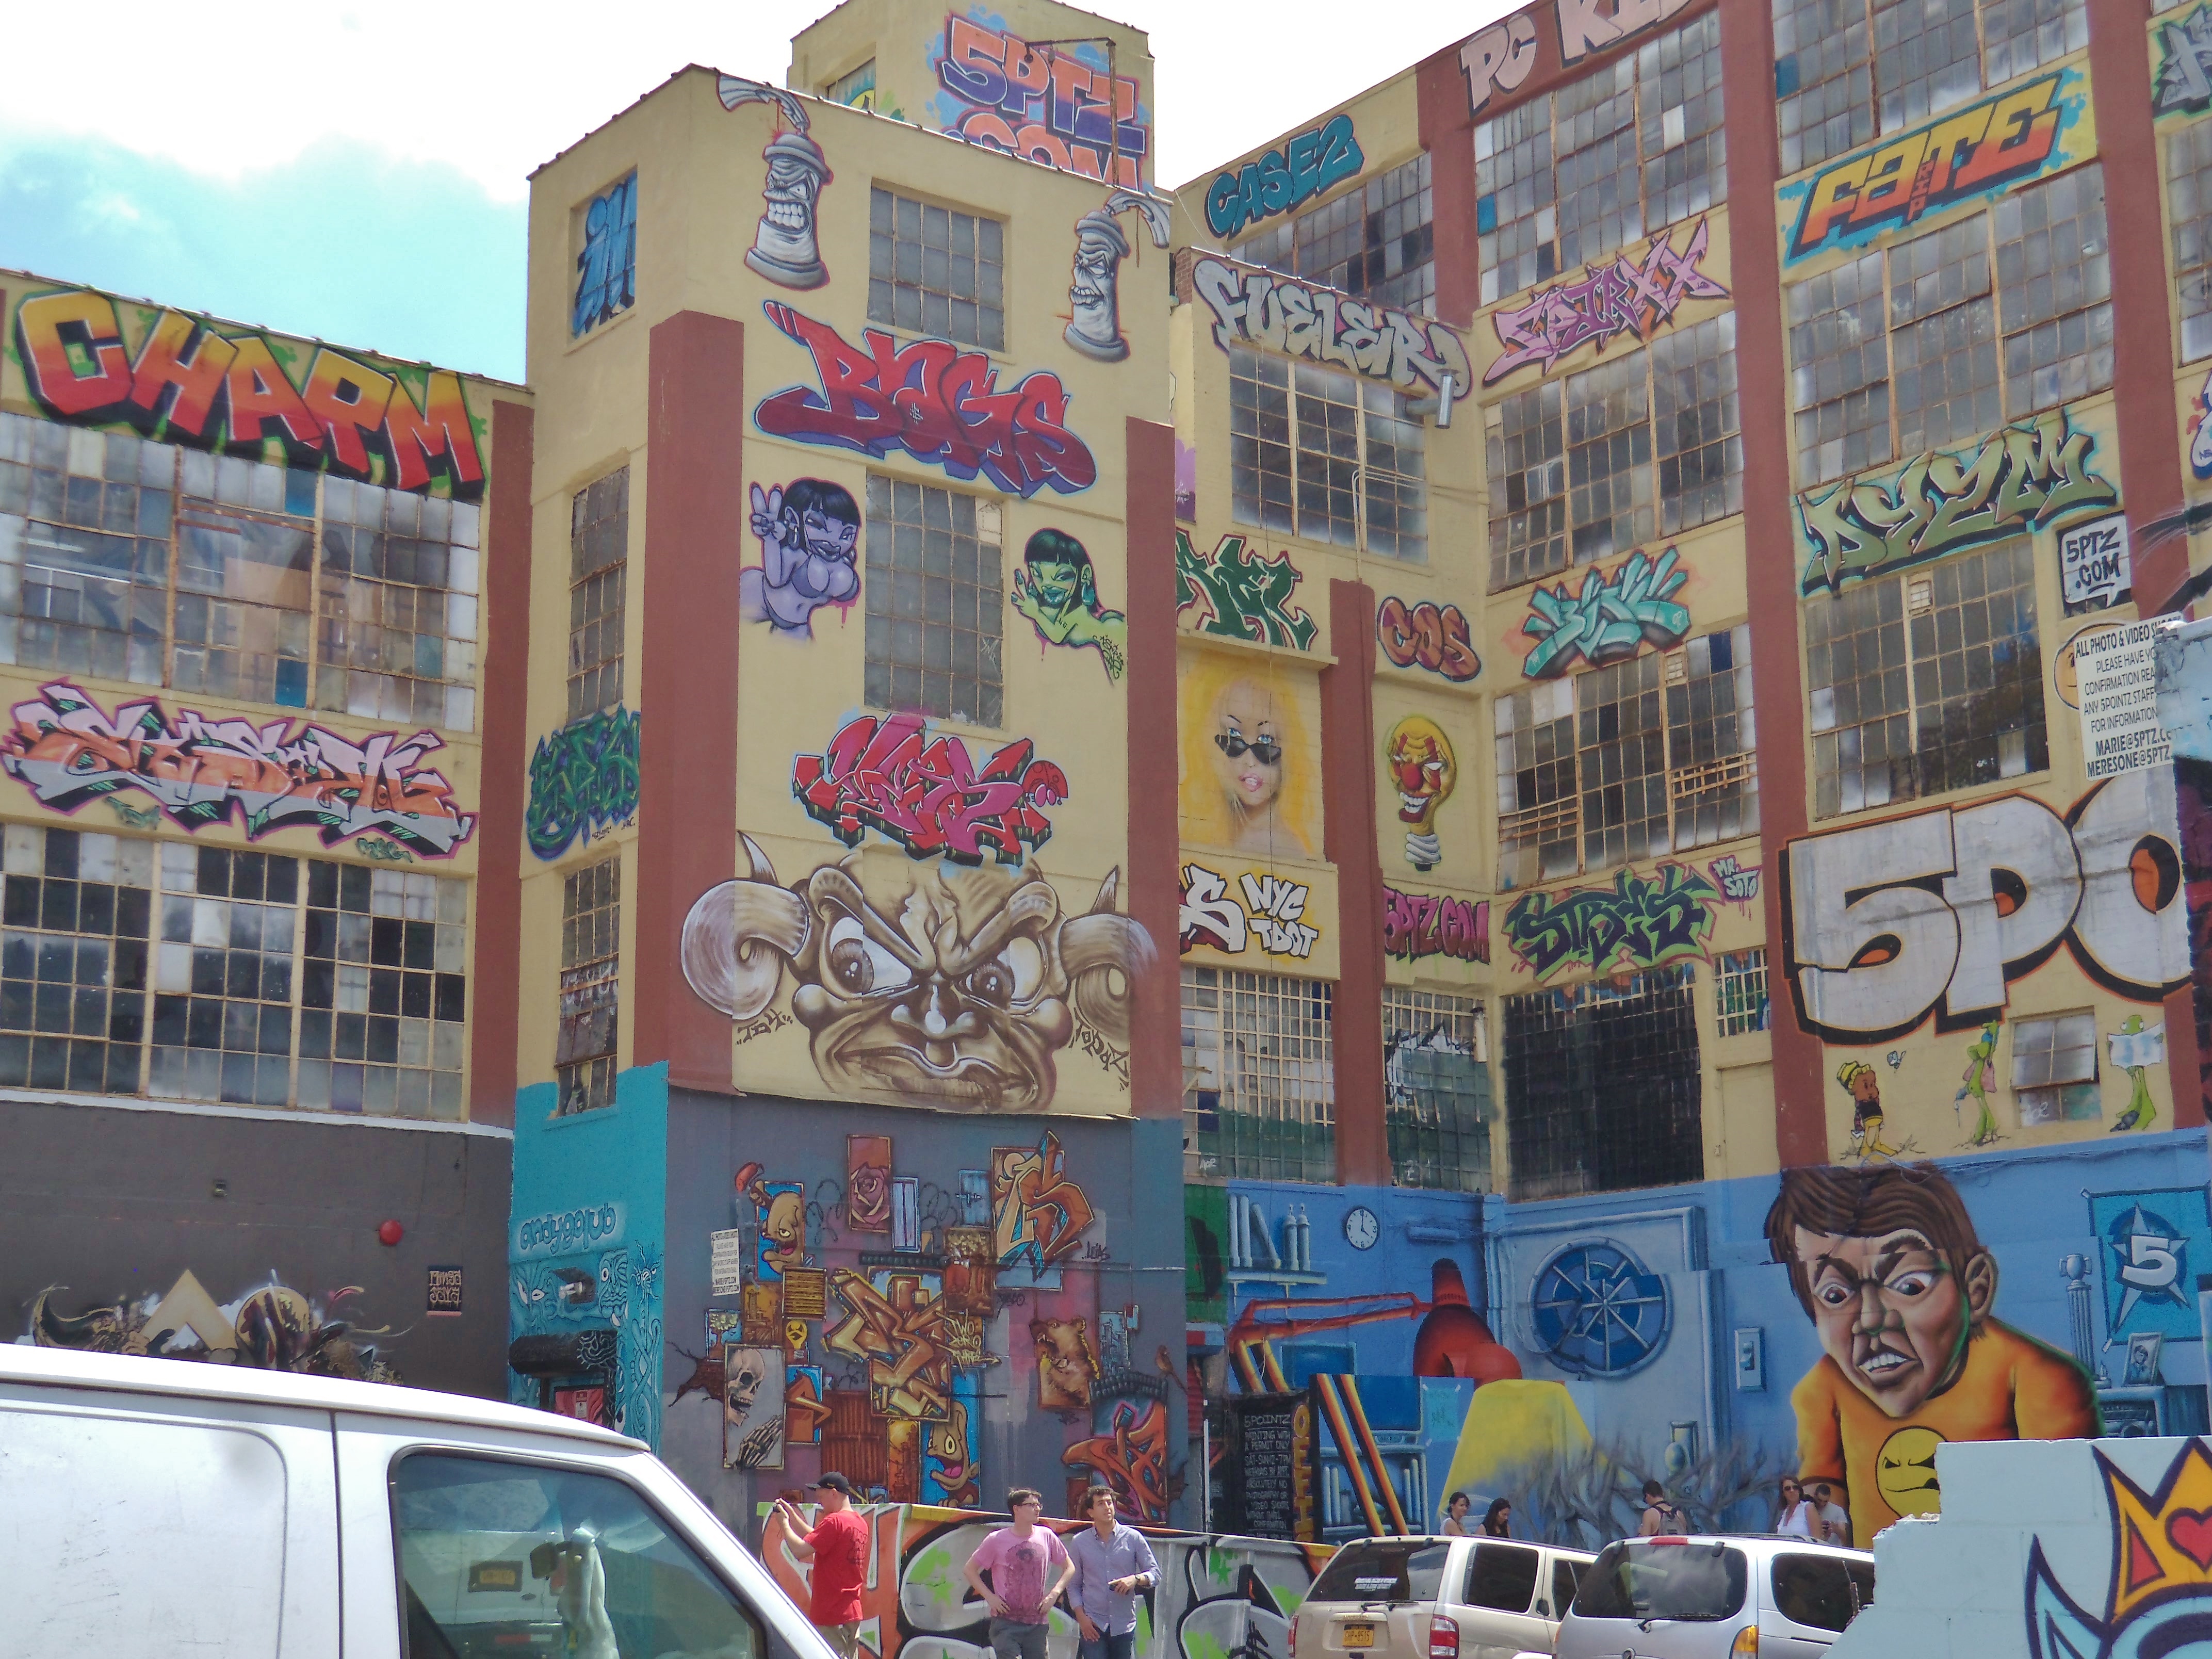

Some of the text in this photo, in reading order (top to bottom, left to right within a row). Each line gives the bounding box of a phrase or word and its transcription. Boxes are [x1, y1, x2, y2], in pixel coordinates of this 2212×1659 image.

[1205, 114, 1364, 239] CASE2
[13, 289, 485, 501] CHARM
[2066, 527, 2121, 562] 5PTZ
[2076, 552, 2121, 588] .COM
[2075, 640, 2089, 658] ALL
[2090, 632, 2117, 655] PHOTO
[2119, 630, 2125, 647] &
[2125, 624, 2150, 645] VIDEO
[2096, 655, 2123, 674] PLEASE
[2124, 649, 2144, 666] HAVE
[2085, 670, 2140, 696] CONFIRMATION
[2084, 687, 2155, 716] ANY 5POINTZ STAFF
[2090, 706, 2157, 733] FOR INFORMATION
[1240, 873, 1309, 921] NYC
[1247, 918, 1319, 958] TDOT
[2122, 1236, 2178, 1287] 5
[1244, 1413, 1291, 1427] 5POINTZ
